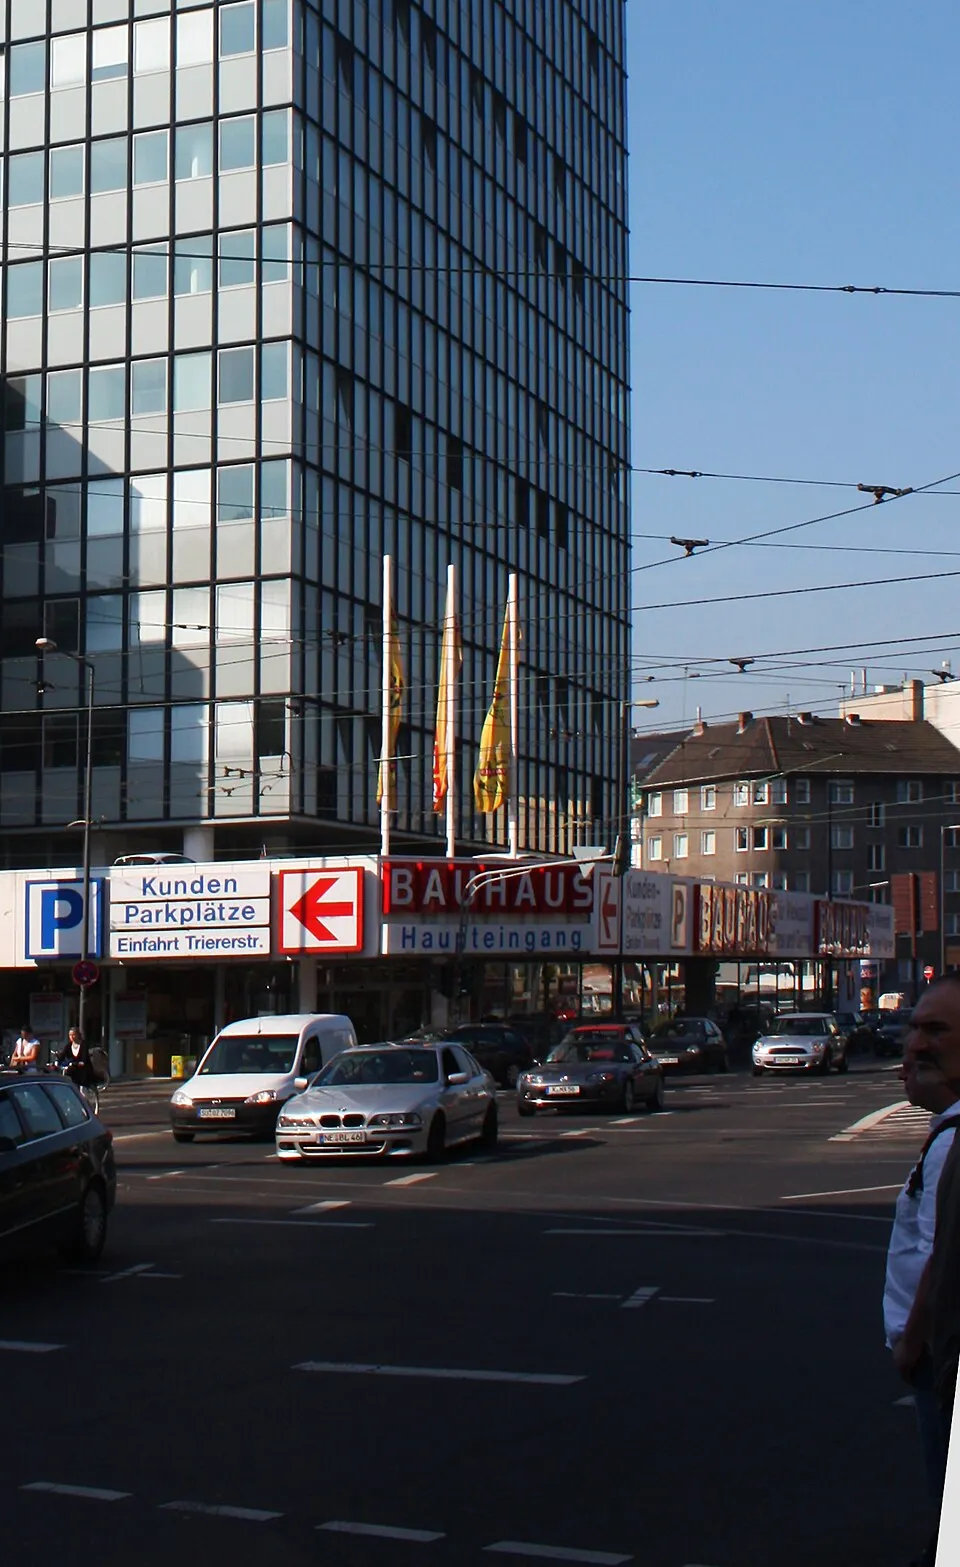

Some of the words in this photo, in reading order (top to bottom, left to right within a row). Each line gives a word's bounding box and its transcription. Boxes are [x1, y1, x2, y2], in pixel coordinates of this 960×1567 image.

[141, 875, 238, 897] Kunden
[390, 868, 594, 908] BAUHAUS
[40, 888, 84, 950] P
[125, 902, 256, 926] Parkplätze
[674, 890, 685, 941] P
[117, 936, 180, 953] Einfahrt
[185, 933, 264, 951] Triererstr.
[401, 925, 582, 952] Haupteingang
